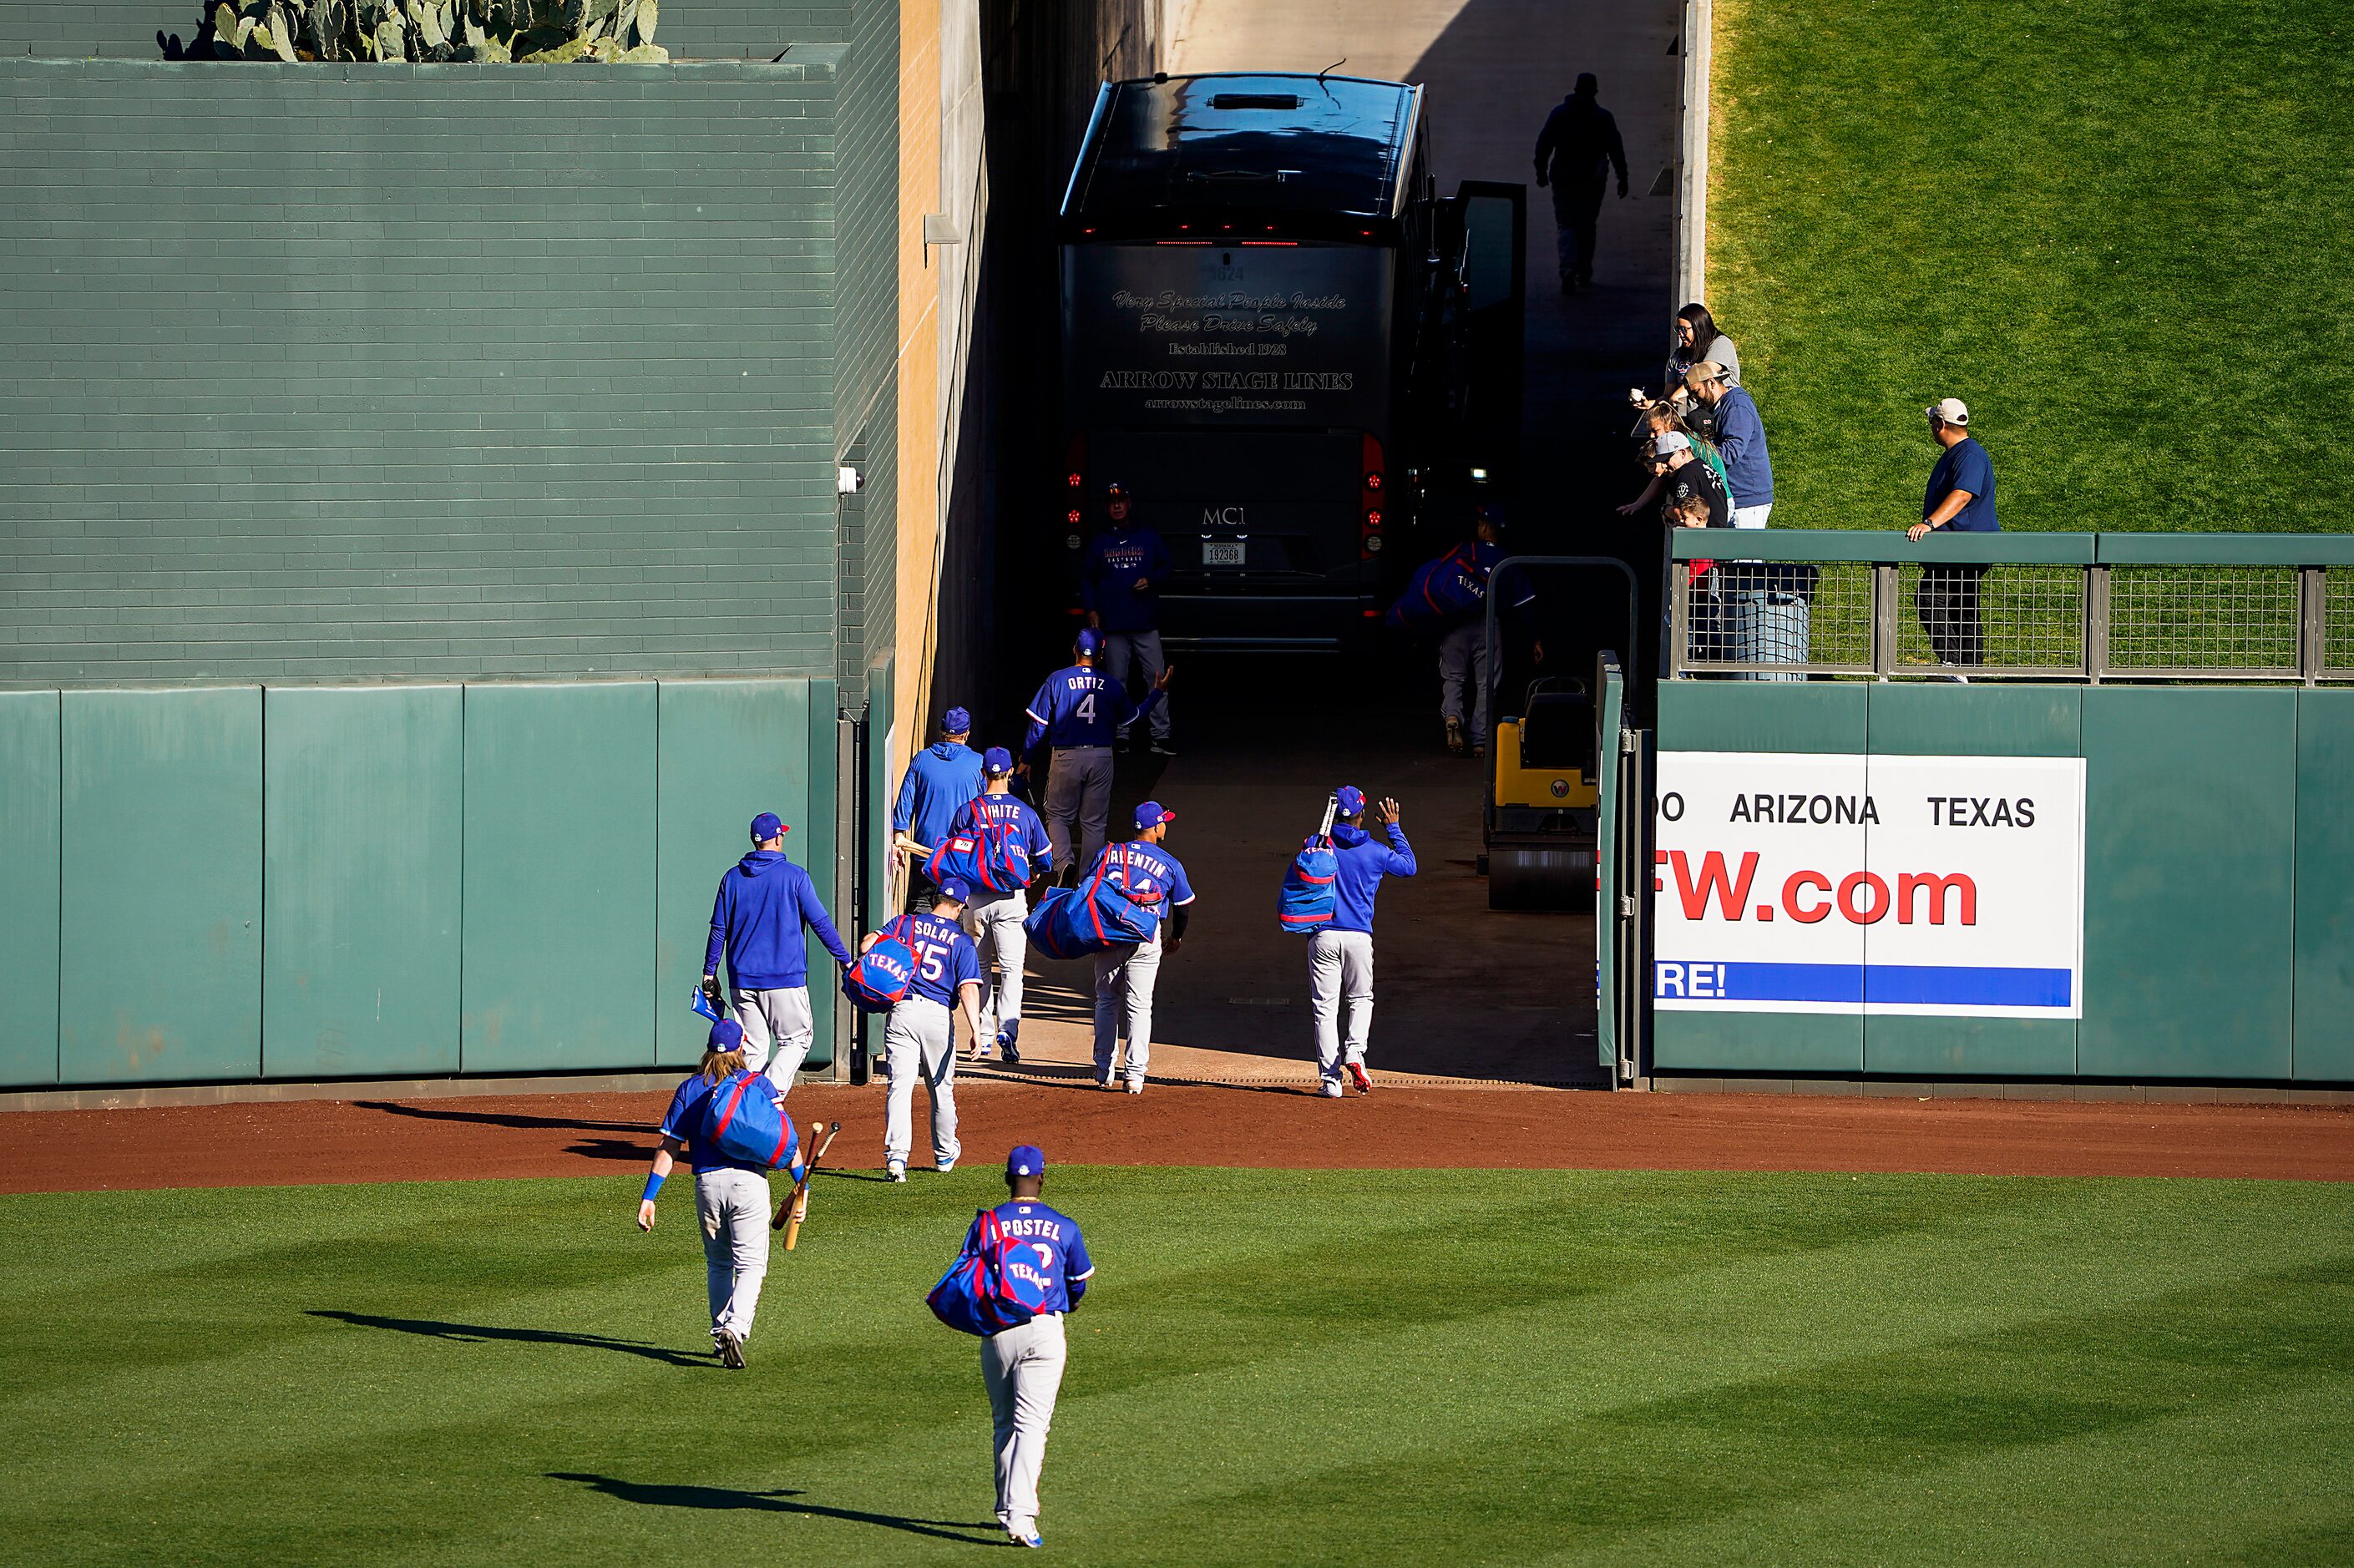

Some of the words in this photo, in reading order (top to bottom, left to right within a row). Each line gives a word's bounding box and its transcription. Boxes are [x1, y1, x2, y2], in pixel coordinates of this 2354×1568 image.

[1112, 291, 1153, 311] Very
[1157, 290, 1224, 312] Special
[1228, 291, 1287, 312] People
[1290, 292, 1346, 309] Inside
[1140, 314, 1200, 332] Please
[1202, 314, 1254, 331] Drive
[1257, 315, 1319, 336] Safely
[1169, 343, 1255, 356] Established
[1258, 343, 1287, 356] 1928
[1099, 371, 1197, 390] ARROW
[1202, 372, 1278, 390] STAGE
[1283, 372, 1354, 391] LINES
[1145, 397, 1306, 414] arrowstagelines.com
[1104, 546, 1144, 558] RANGERS
[1209, 549, 1239, 560] 192368
[1457, 575, 1486, 599] TEXAS
[1068, 676, 1106, 690] ORTIZ
[1076, 694, 1096, 724] 4
[1729, 793, 1880, 825] ARIZONA
[1927, 797, 2035, 827] TEXAS
[914, 921, 959, 946] SOLAK
[868, 953, 908, 984] TEXAS
